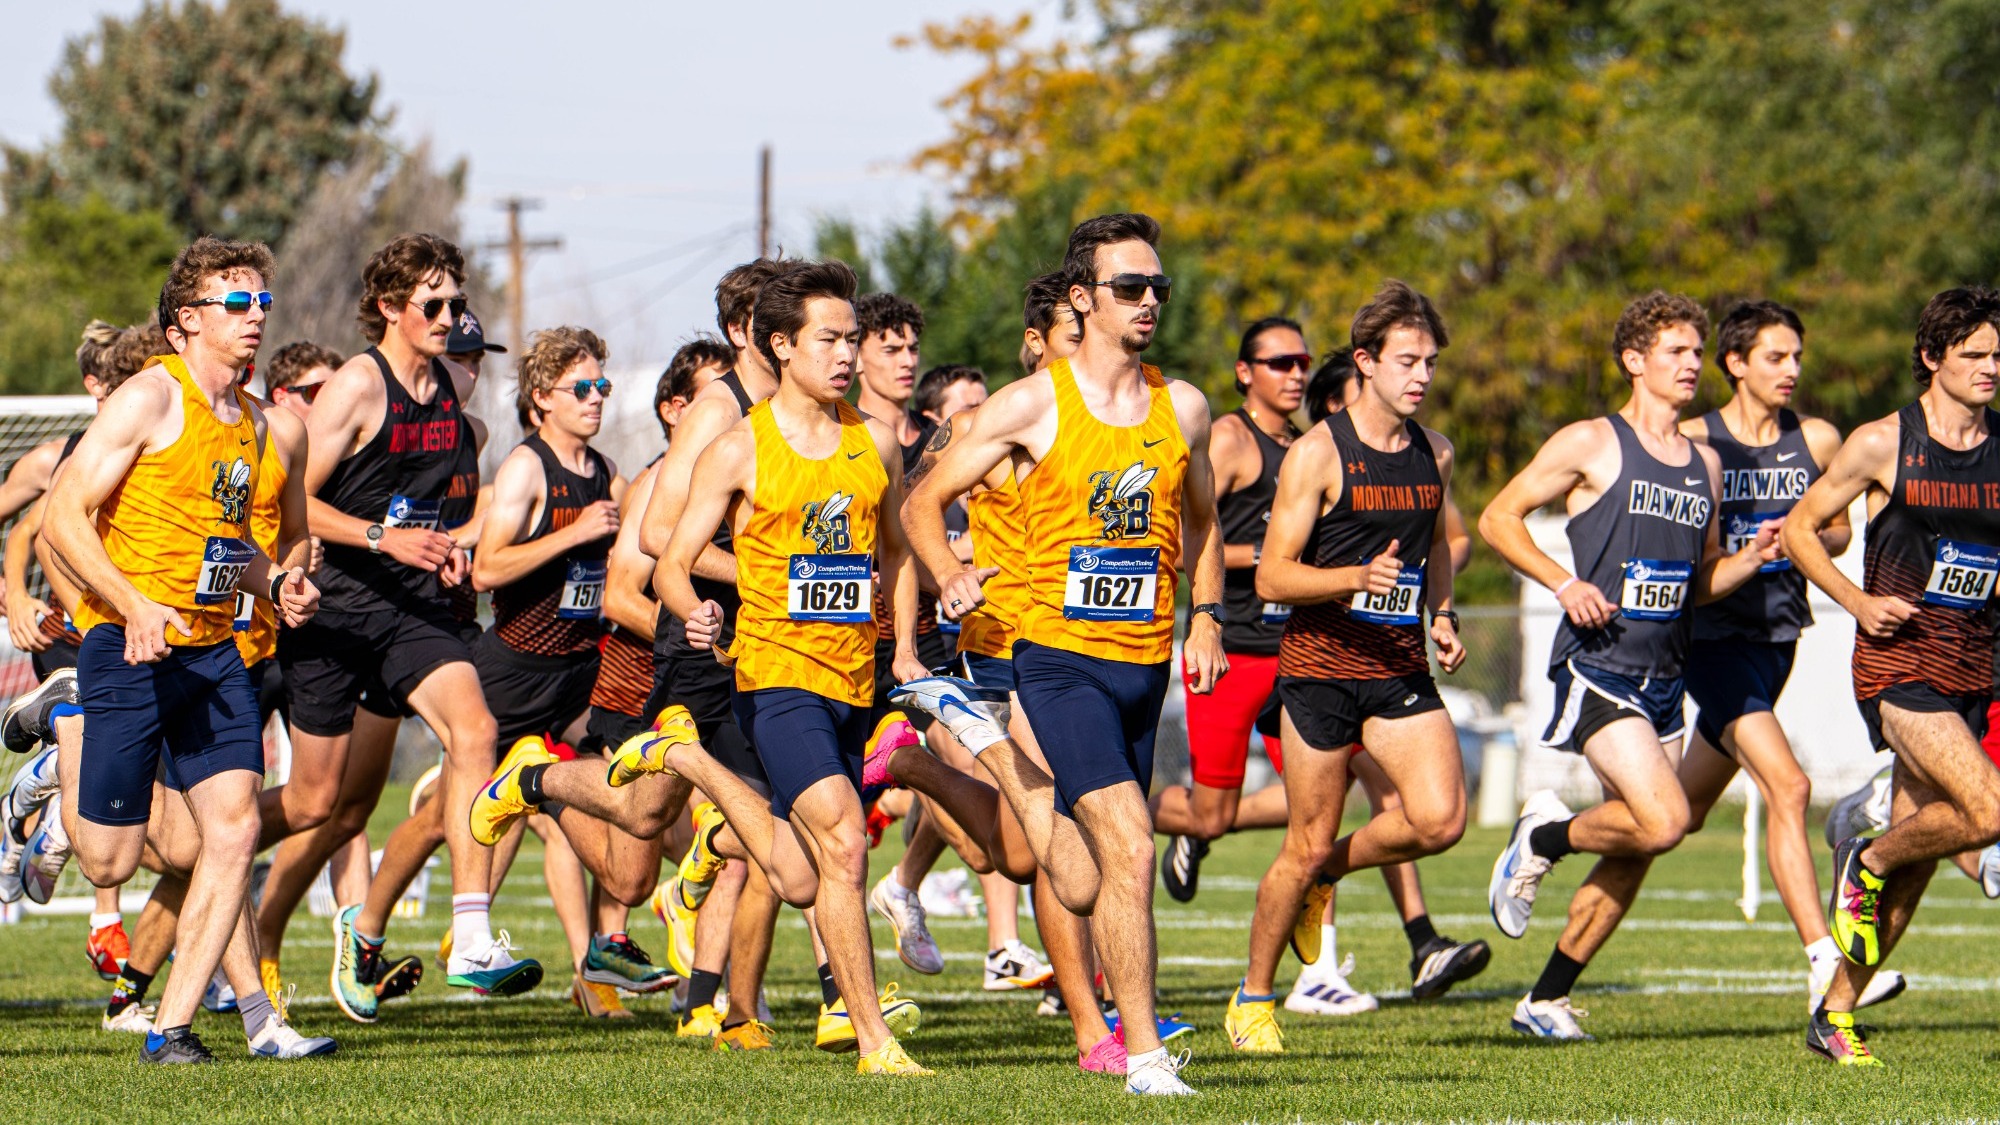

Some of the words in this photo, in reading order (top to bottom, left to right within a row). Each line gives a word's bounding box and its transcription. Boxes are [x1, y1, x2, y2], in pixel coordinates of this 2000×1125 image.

[1351, 484, 1416, 512] MONTANA
[1722, 467, 1810, 502] HAWKS
[1905, 479, 1980, 510] MONTANA
[1983, 482, 2000, 510] TE
[1628, 479, 1711, 530] HAWKS
[797, 581, 860, 611] 1629
[1079, 575, 1144, 608] 1627
[1633, 583, 1683, 609] 1564
[1938, 566, 1990, 598] 1584
[1363, 587, 1412, 613] 1589
